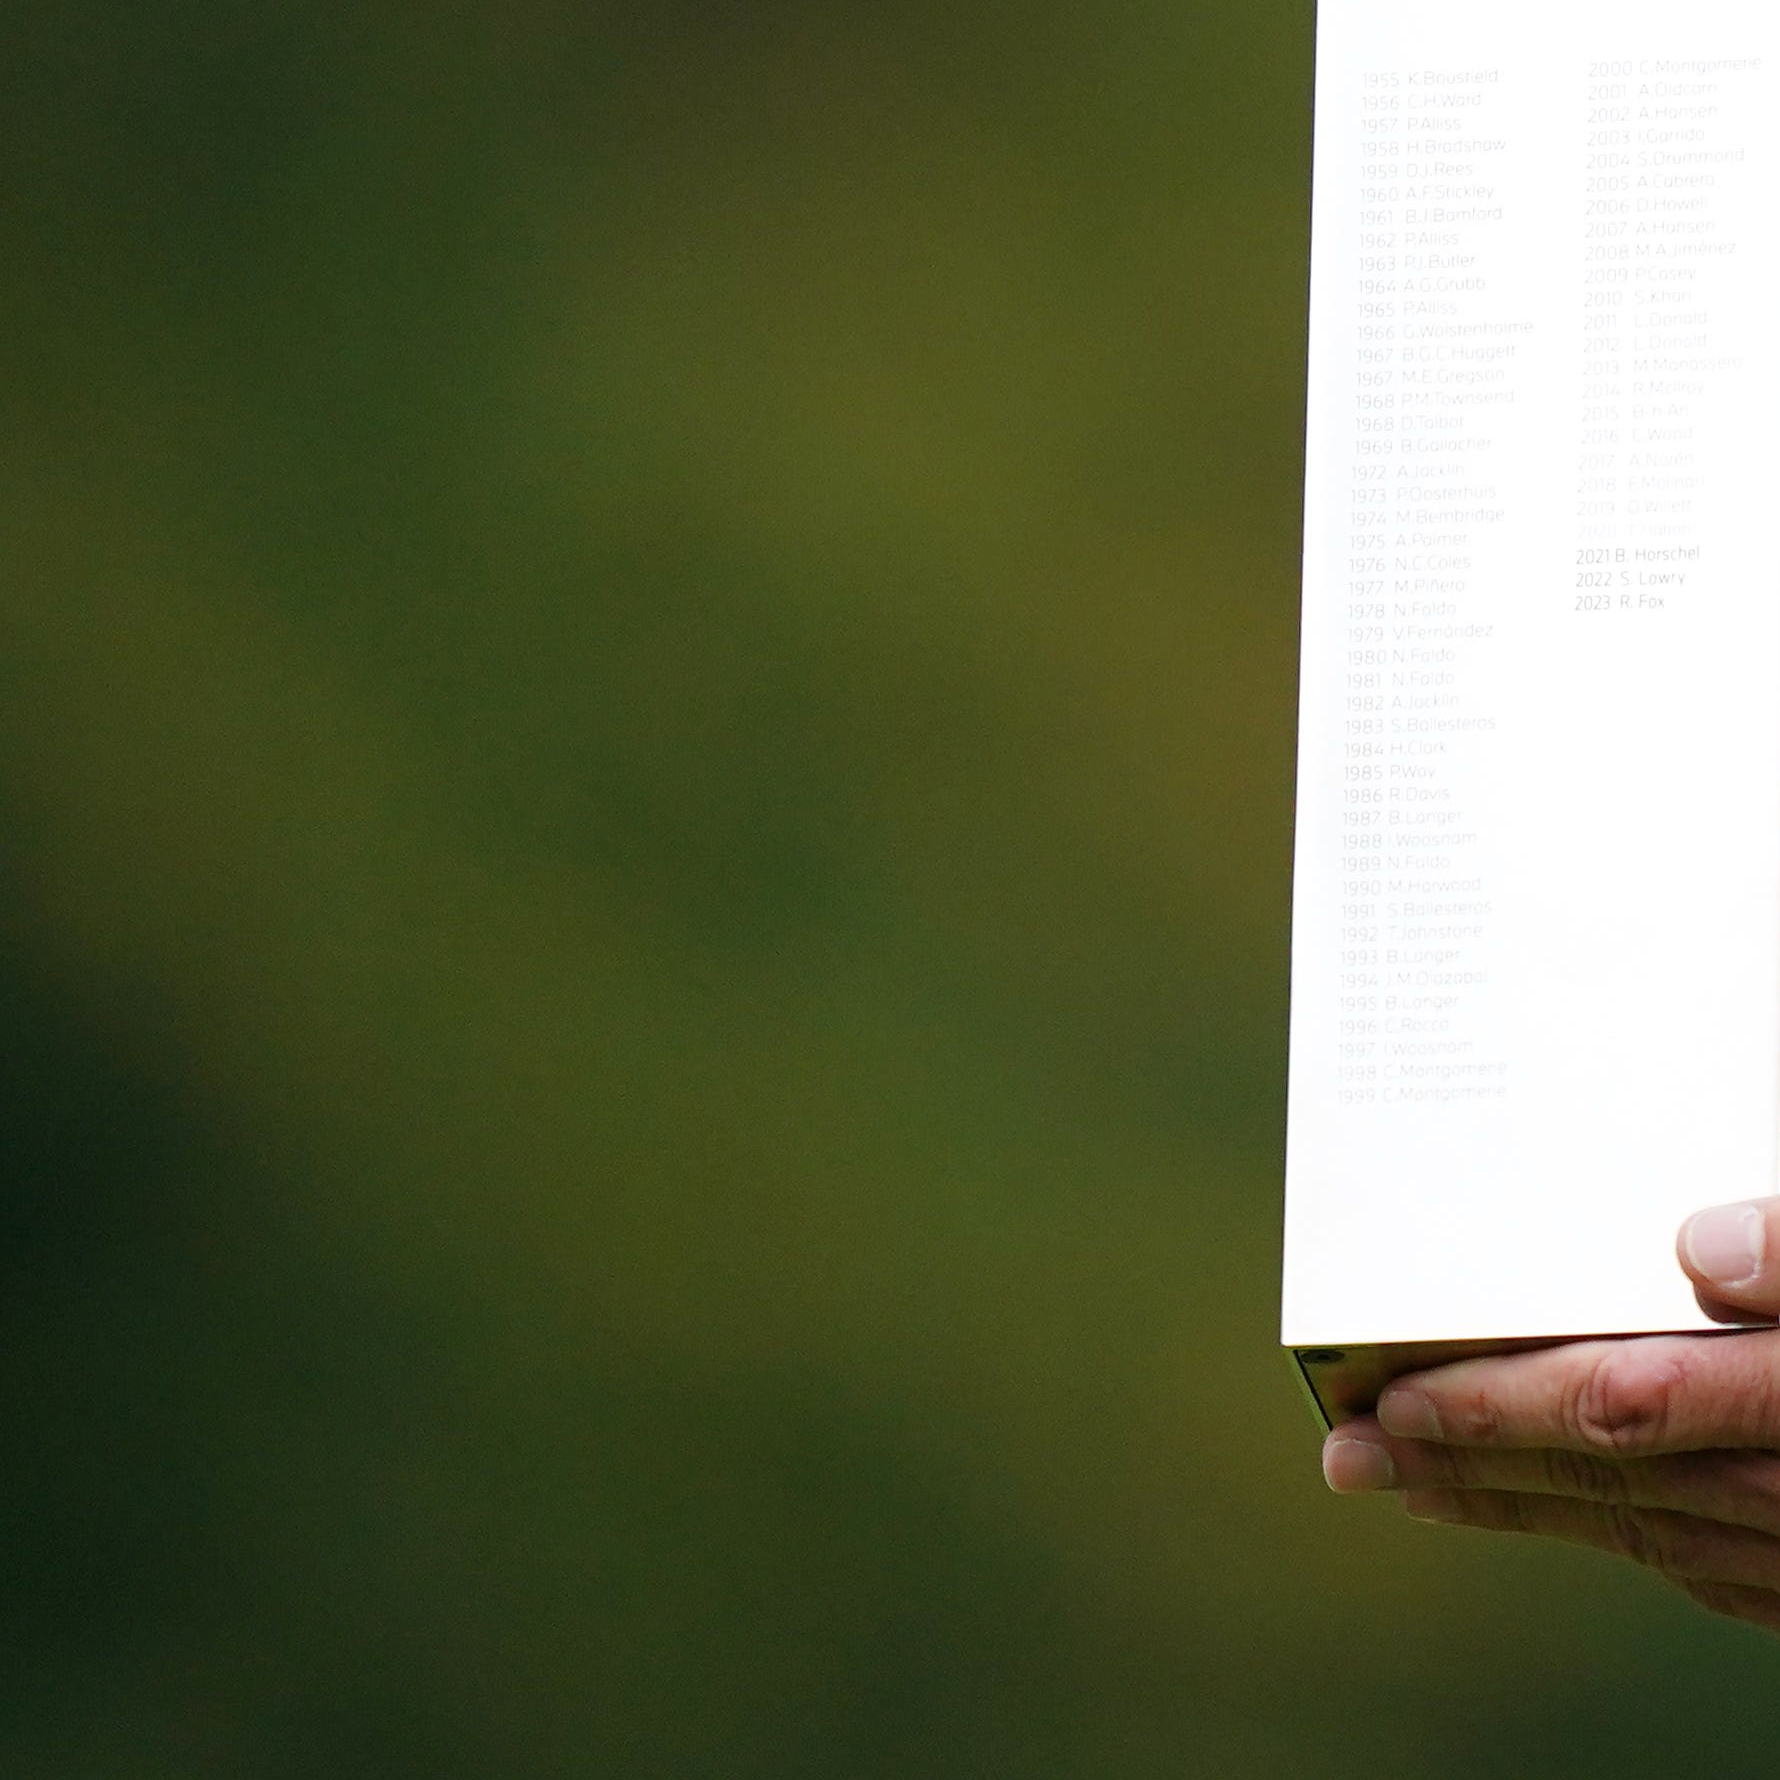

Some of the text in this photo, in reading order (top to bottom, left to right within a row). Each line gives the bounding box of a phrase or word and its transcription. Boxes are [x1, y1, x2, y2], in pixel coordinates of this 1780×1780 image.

[1588, 60, 1633, 78] 2000
[1363, 72, 1400, 88] 1955
[1588, 84, 1627, 100] 2001
[1362, 95, 1400, 111] 1956
[1587, 107, 1631, 123] 2002
[1361, 118, 1398, 134] 1957
[1587, 130, 1630, 147] 2003
[1360, 141, 1399, 156] 1958
[1586, 153, 1630, 169] 2004
[1360, 164, 1398, 180] 1959
[1586, 175, 1629, 192] 2005
[1360, 187, 1399, 203] 1960
[1585, 198, 1630, 215] 2006
[1360, 210, 1393, 225] 1961
[1585, 221, 1627, 238] 2007
[1360, 233, 1397, 249] 1962
[1584, 244, 1629, 261] 2008
[1359, 256, 1396, 272] 1963
[1584, 267, 1628, 284] 2009
[1359, 279, 1396, 295] 1964
[1584, 290, 1622, 307] 2010
[1358, 302, 1395, 318] 1965
[1584, 314, 1616, 330] 2011
[1358, 325, 1395, 340] 1966
[1583, 337, 1620, 353] 2012
[1357, 348, 1394, 363] 1967
[1582, 360, 1619, 376] 2013
[1357, 370, 1393, 387] 1967
[1582, 383, 1620, 399] 2014
[1356, 393, 1395, 409] 1968
[1582, 406, 1619, 422] 2015
[1356, 417, 1394, 432] 1968
[1581, 428, 1619, 445] 2016
[1355, 439, 1393, 455] 1969
[1578, 453, 1615, 471] 2017
[1352, 465, 1387, 480] 1972
[1577, 477, 1617, 493] 2018
[1352, 488, 1386, 503] 1973
[1577, 500, 1615, 516] 2019
[1351, 511, 1386, 527] 1974
[1350, 534, 1385, 550] 1975
[1576, 544, 1700, 565] 2021 B. Horschel
[1349, 557, 1386, 573] 1976
[1576, 571, 1686, 587] 2022 S. Lowry
[1348, 580, 1384, 596] 1977
[1575, 593, 1665, 611] 2023 R. Fox
[1348, 604, 1385, 619] 1978
[1348, 627, 1384, 642] 1979
[1347, 650, 1387, 665] 1980
[1346, 673, 1381, 688] 1981
[1346, 696, 1384, 712] 1982
[1346, 719, 1384, 735] 1983
[1345, 742, 1384, 758] 1984
[1344, 765, 1383, 780] 1985
[1344, 788, 1383, 804] 1986
[1343, 811, 1381, 827] 1987
[1342, 834, 1383, 849] 1988
[1342, 857, 1381, 872] 1989
[1343, 880, 1382, 896] 1990
[1342, 904, 1376, 920] 1991
[1341, 927, 1378, 942] 1992
[1341, 950, 1378, 966] 1993
[1340, 973, 1378, 988] 1994
[1339, 996, 1377, 1012] 1995
[1339, 1020, 1377, 1035] 1996
[1338, 1042, 1377, 1059] 1997
[1338, 1066, 1377, 1081] 1998
[1338, 1089, 1376, 1105] 1999
